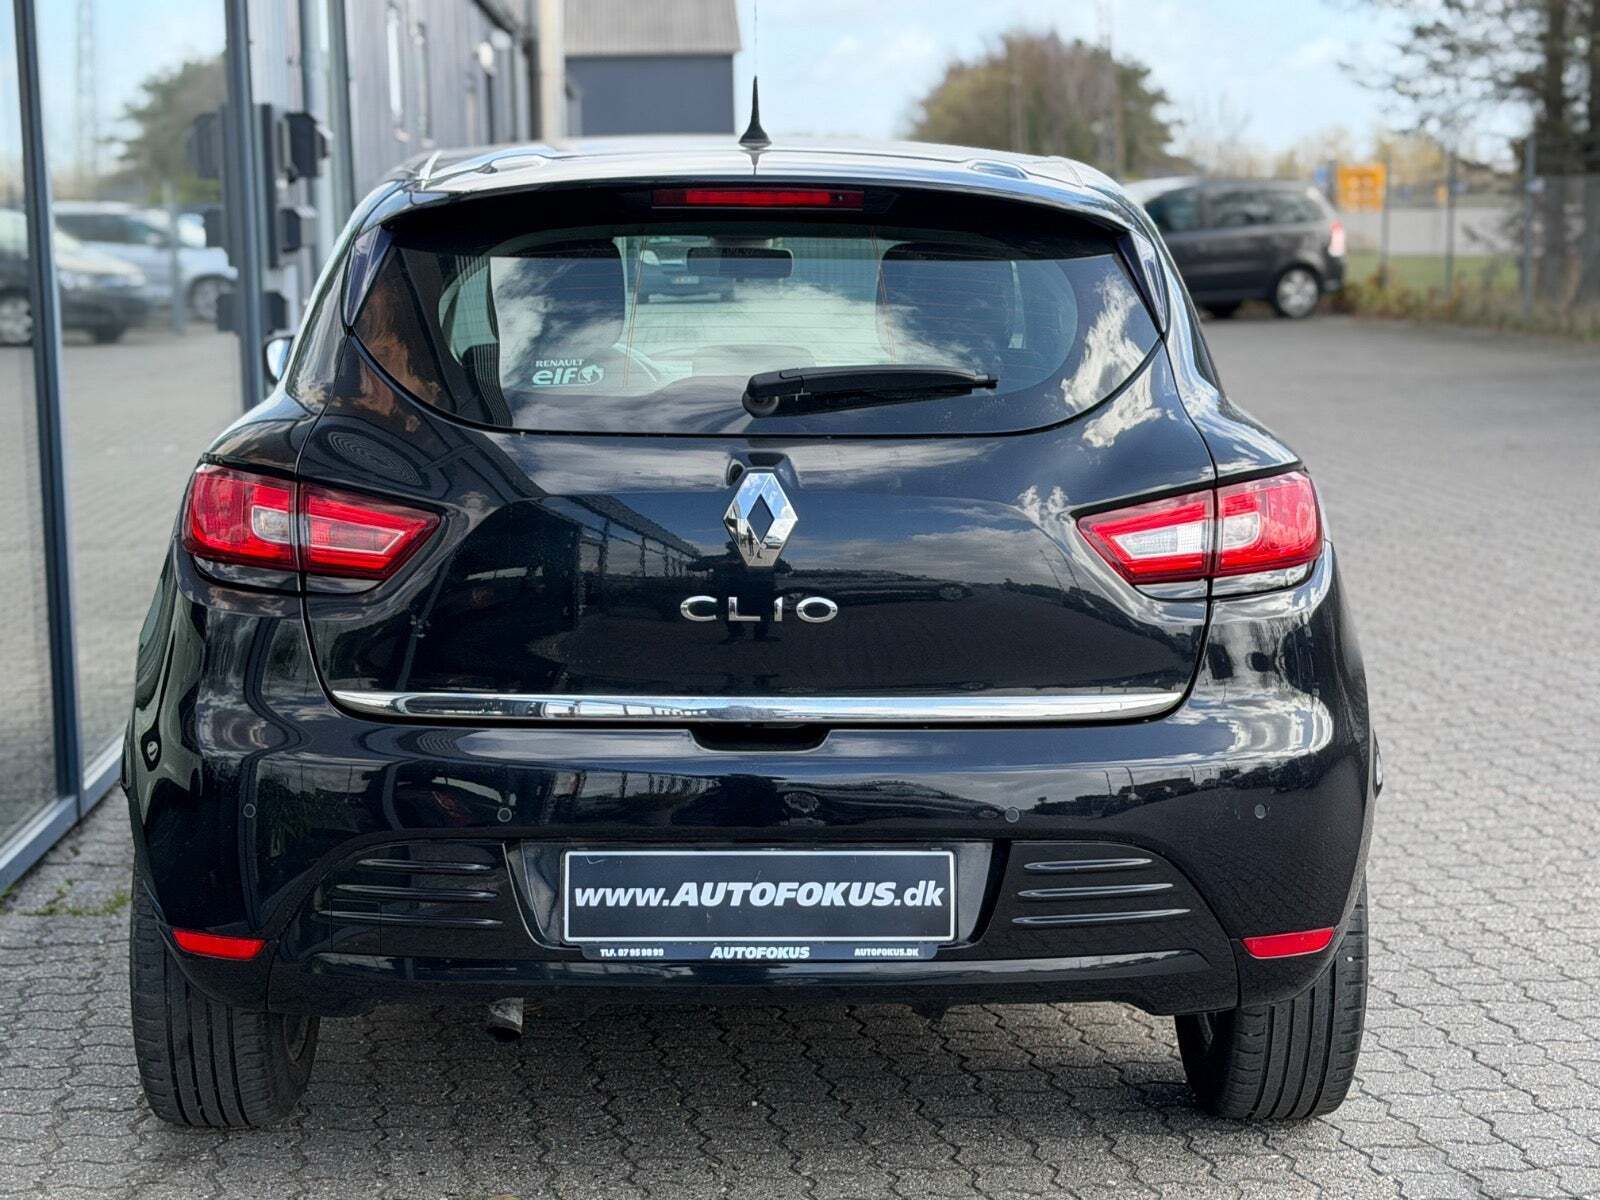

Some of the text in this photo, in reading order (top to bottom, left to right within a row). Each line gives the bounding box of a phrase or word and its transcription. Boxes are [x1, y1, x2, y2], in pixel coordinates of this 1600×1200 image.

[535, 359, 584, 367] RENAULT
[680, 595, 838, 623] CLIO
[575, 880, 945, 907] www.AUTOFOKUS.dk
[710, 946, 810, 959] AUTOFOKUS
[854, 947, 919, 957] AUTOFOKUS.DK
